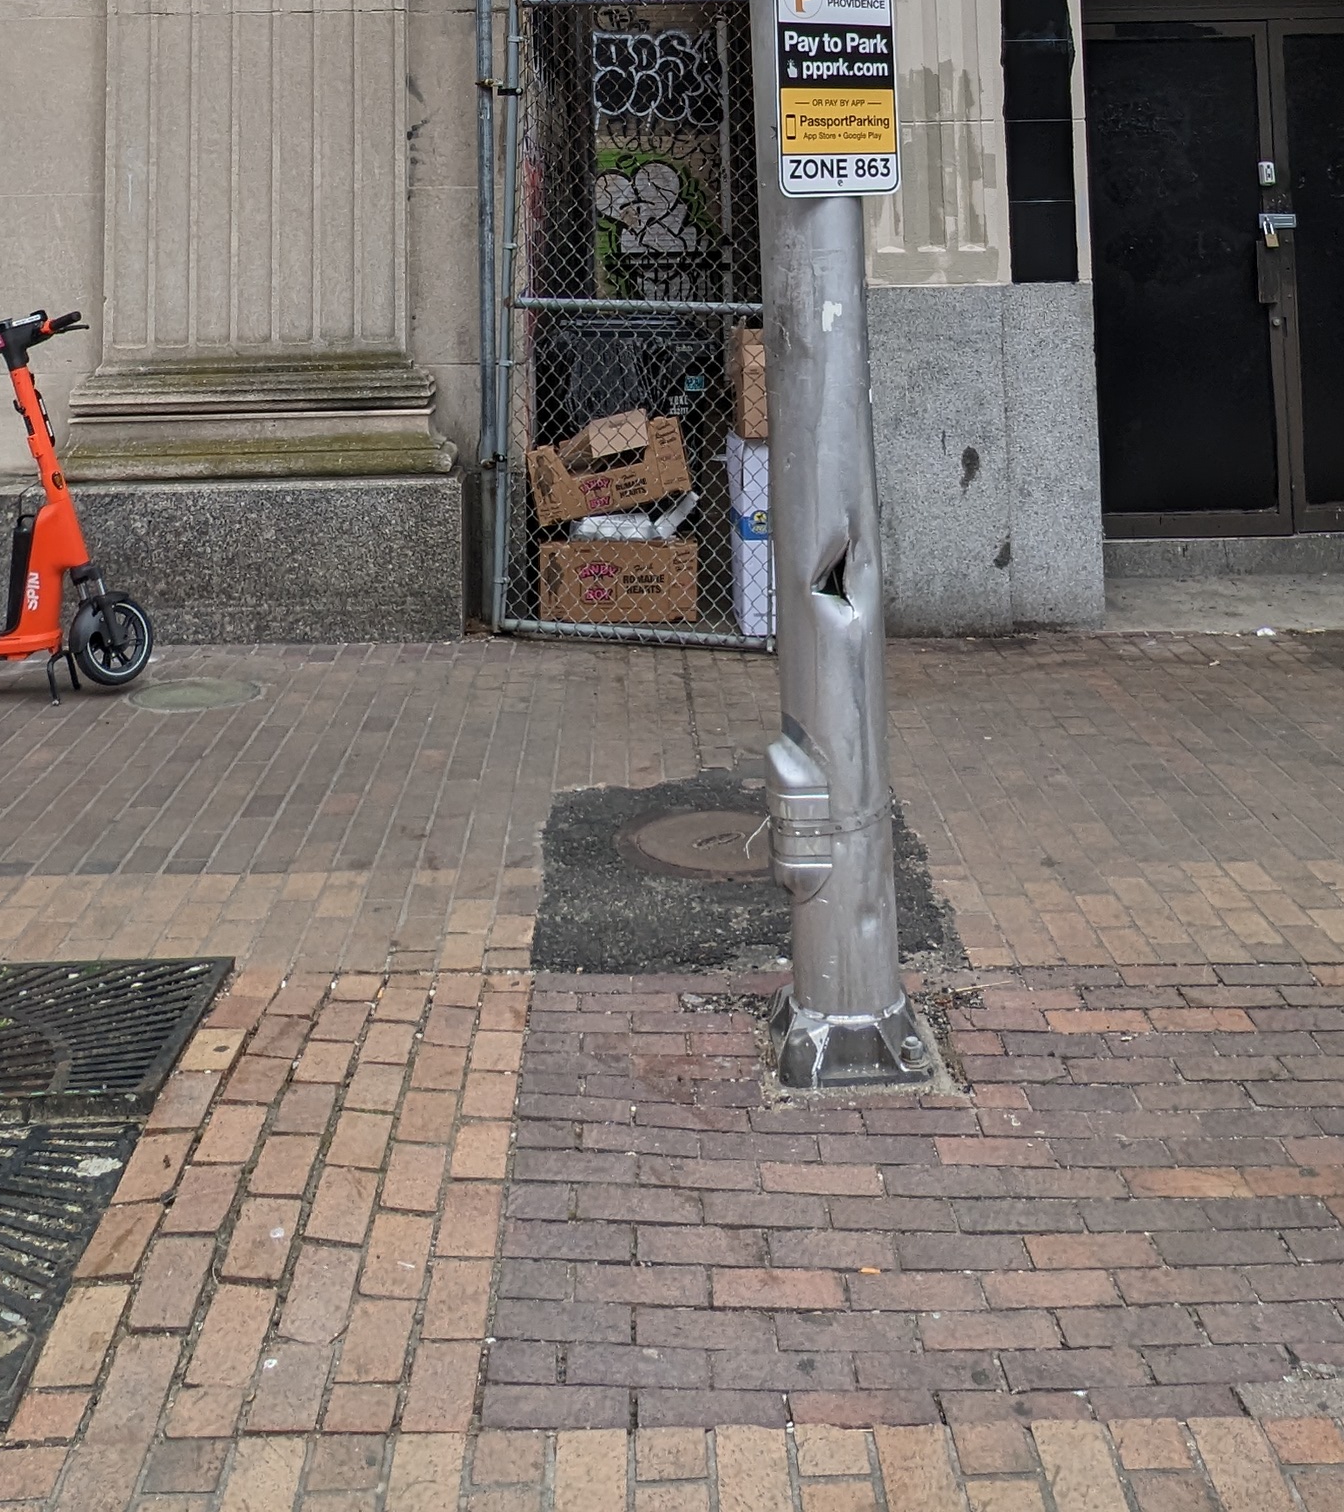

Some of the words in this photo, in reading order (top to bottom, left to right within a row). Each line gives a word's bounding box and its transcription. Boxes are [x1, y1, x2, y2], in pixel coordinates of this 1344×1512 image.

[784, 30, 820, 57] Pay
[822, 34, 843, 54] to
[846, 33, 888, 55] Park
[802, 58, 889, 80] ppprk.com
[812, 99, 823, 107] OR
[824, 99, 838, 107] PAY
[839, 99, 850, 107] BY
[851, 99, 866, 107] APP
[799, 114, 891, 131] PassportParking
[803, 131, 817, 141] App
[818, 131, 836, 140] Store
[842, 131, 867, 141] Google
[867, 131, 882, 141] Play
[789, 158, 849, 180] ZONE
[854, 157, 892, 179] 863
[27, 571, 41, 611] SPIN
